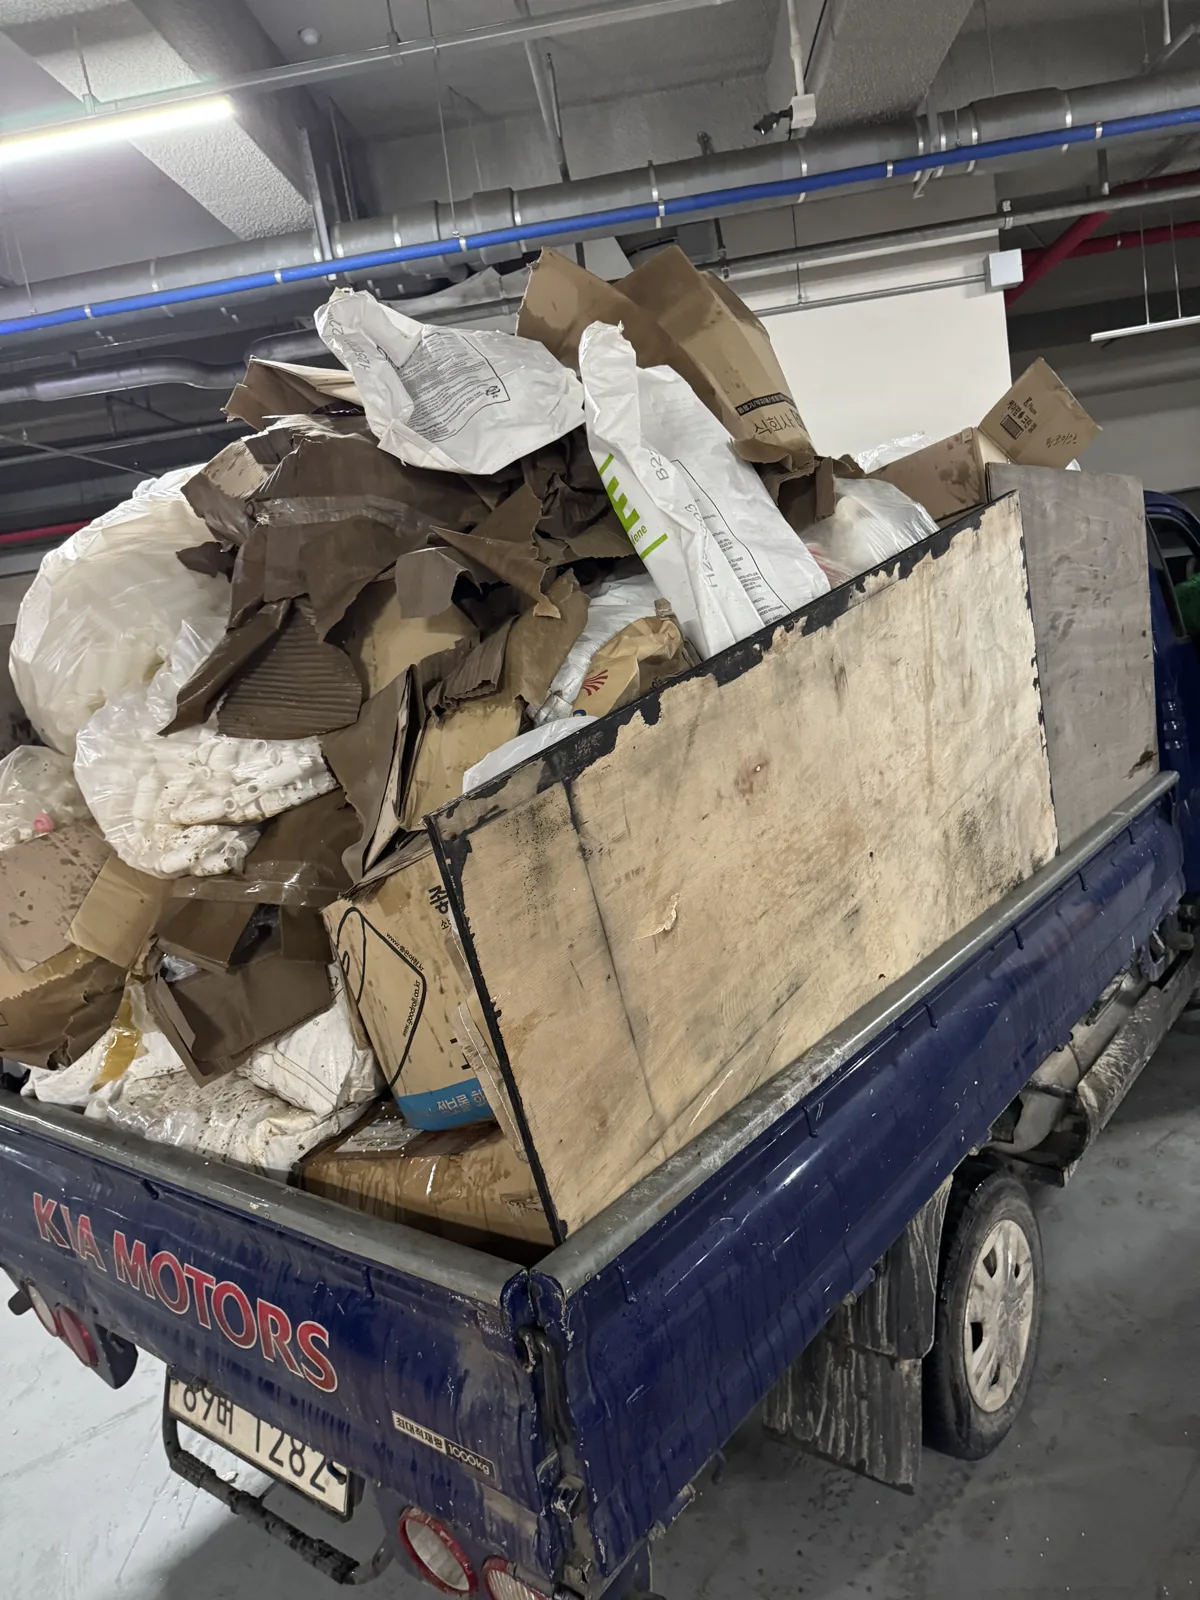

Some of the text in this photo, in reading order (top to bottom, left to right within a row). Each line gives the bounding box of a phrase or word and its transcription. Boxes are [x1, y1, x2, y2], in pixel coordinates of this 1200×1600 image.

[33, 1191, 339, 1393] KIA MOTORS
[395, 1417, 490, 1475] 최대적재량 1000kg
